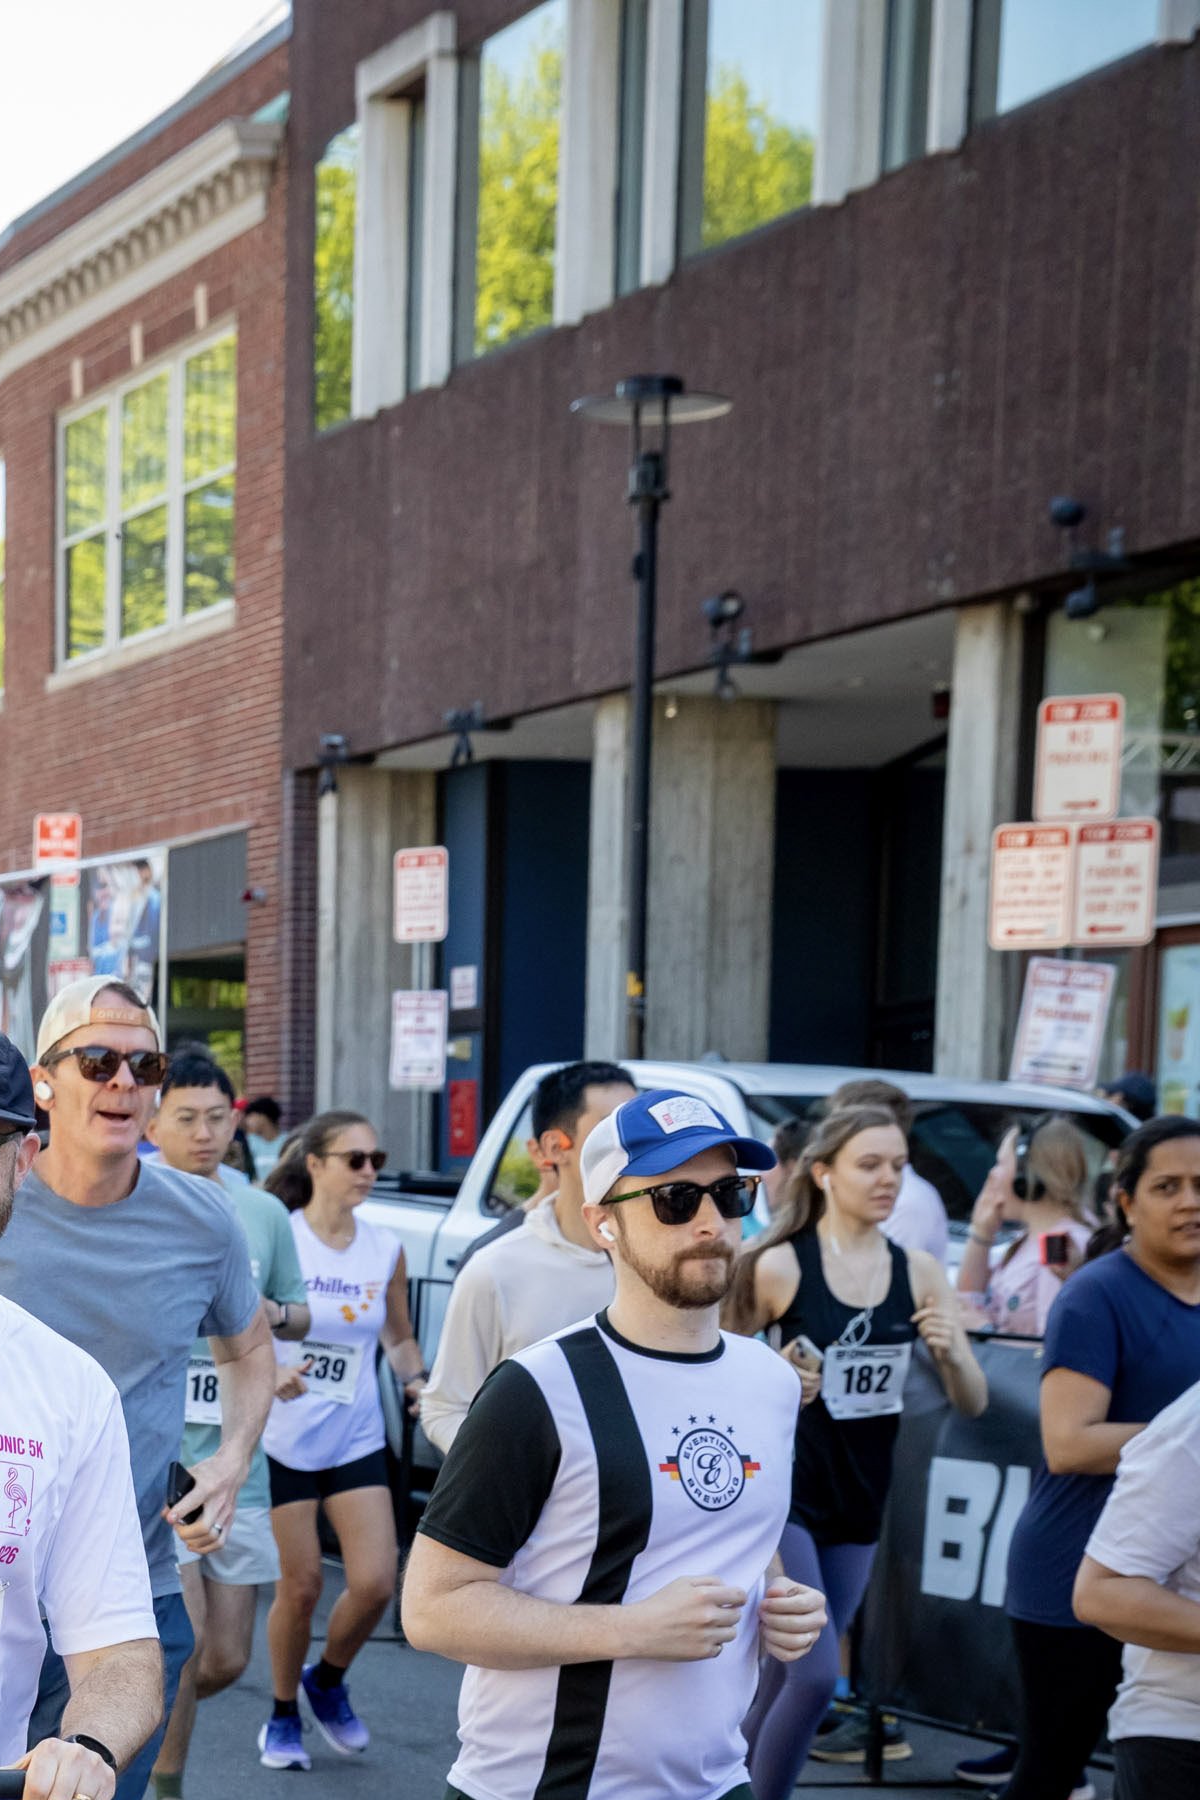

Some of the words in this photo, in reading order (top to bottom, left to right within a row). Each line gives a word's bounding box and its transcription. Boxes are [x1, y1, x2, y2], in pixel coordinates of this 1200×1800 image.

[302, 1353, 347, 1382] 239
[843, 1364, 893, 1395] 182
[28, 1439, 44, 1460] 5K
[682, 1435, 735, 1460] EVENTIDE
[686, 1476, 740, 1505] BREWING
